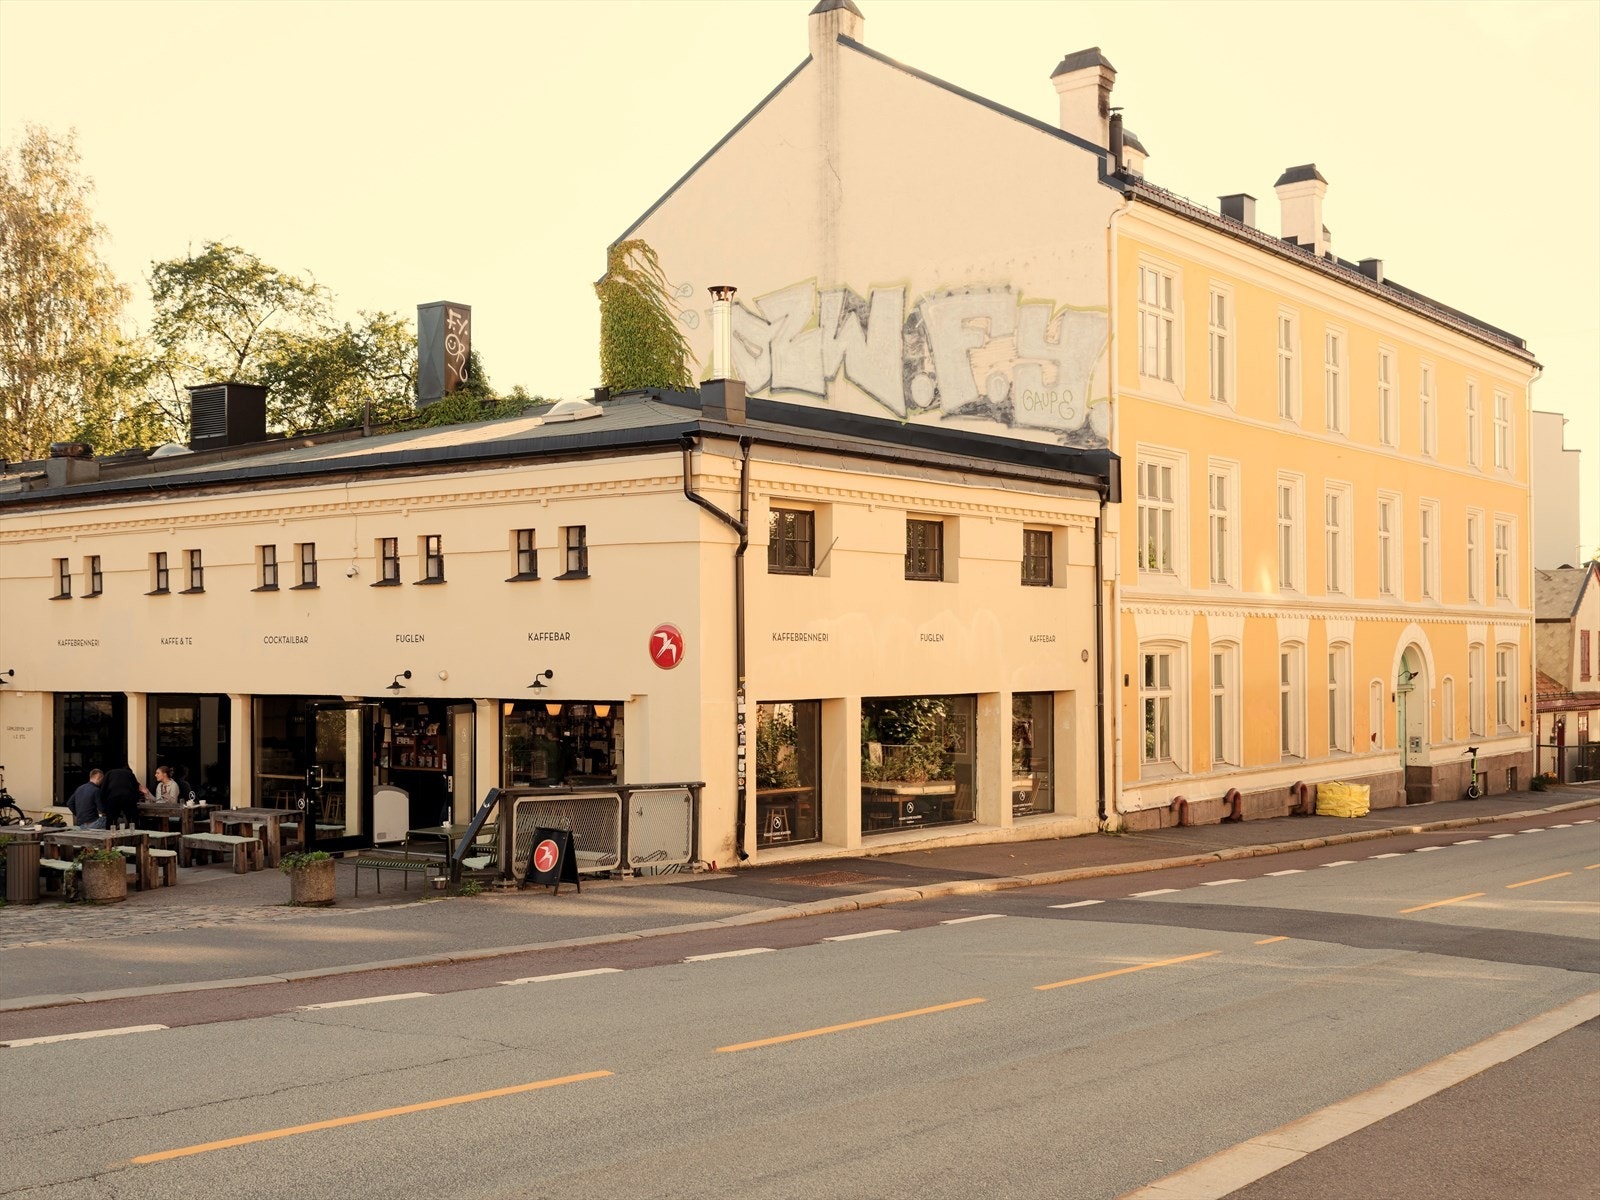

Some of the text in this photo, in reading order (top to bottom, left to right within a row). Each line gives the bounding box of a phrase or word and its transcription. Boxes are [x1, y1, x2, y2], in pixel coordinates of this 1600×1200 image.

[160, 636, 179, 646] KAFFE
[185, 636, 193, 646] TE
[263, 635, 309, 645] COCKTAILBAR
[395, 633, 425, 643] FUGLEN
[527, 631, 571, 642] KAFFEBAR
[772, 632, 829, 642] KAFFEBRENNERI
[920, 633, 944, 643] FUGLEN
[1029, 634, 1056, 643] KAFFEBAR
[57, 638, 100, 647] KAFFEBRENNERI
